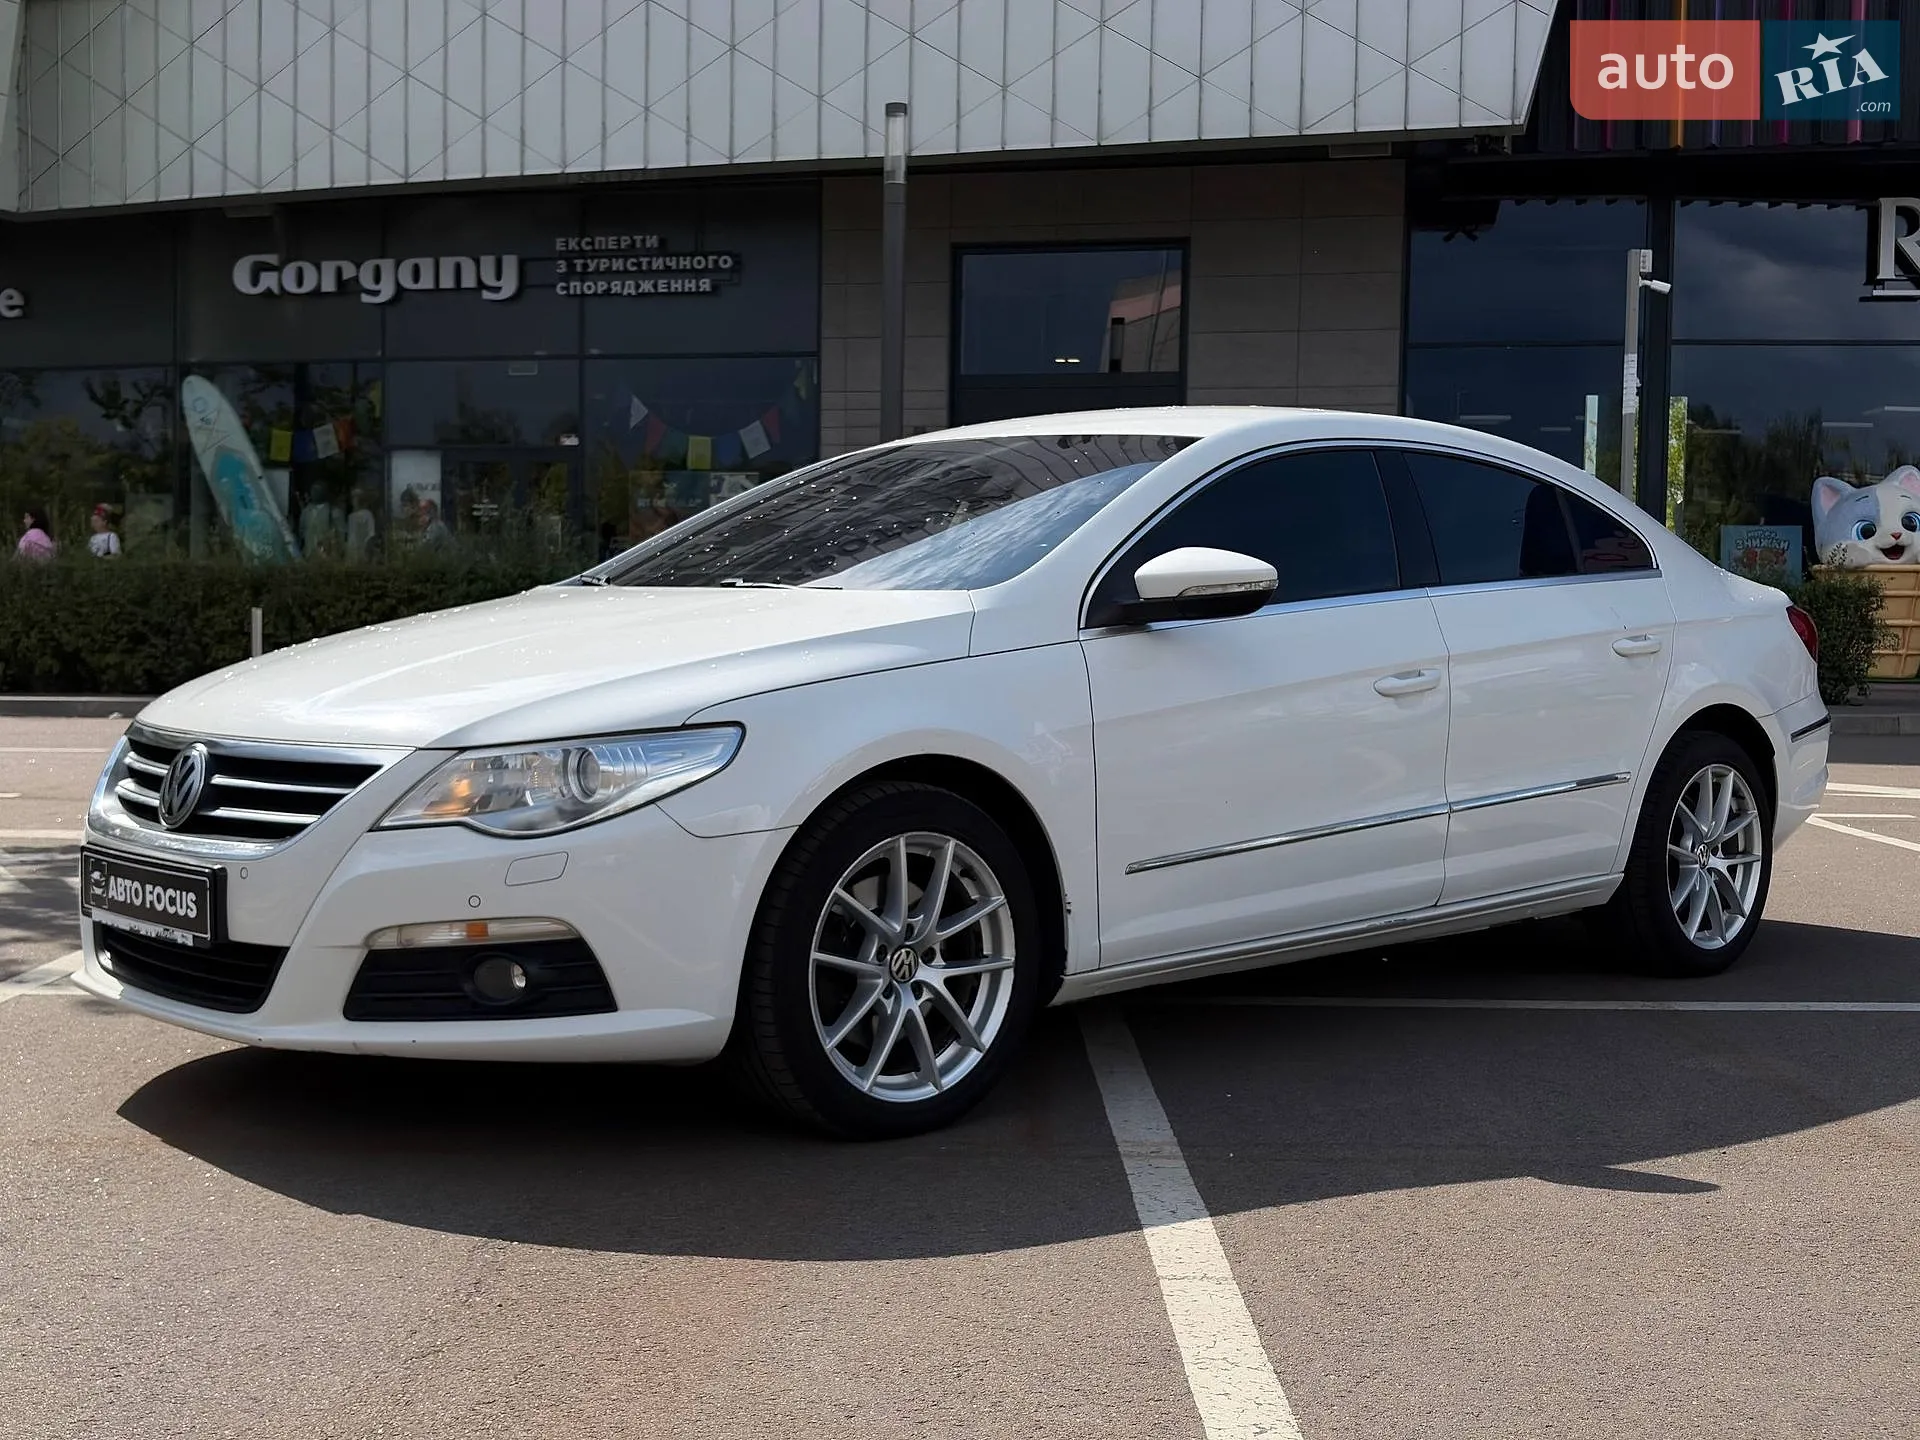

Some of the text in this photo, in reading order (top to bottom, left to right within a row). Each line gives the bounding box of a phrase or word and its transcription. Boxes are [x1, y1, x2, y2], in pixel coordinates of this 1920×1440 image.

[555, 235, 660, 250] ЕКСПЕРТИ
[573, 255, 733, 273] ТУРИСТИЧНОГО
[232, 253, 519, 303] Gorgany
[555, 278, 713, 296] СПОРЯДЖЕННЯ
[0, 287, 25, 318] e
[108, 875, 198, 919] АВТО FOCUS
